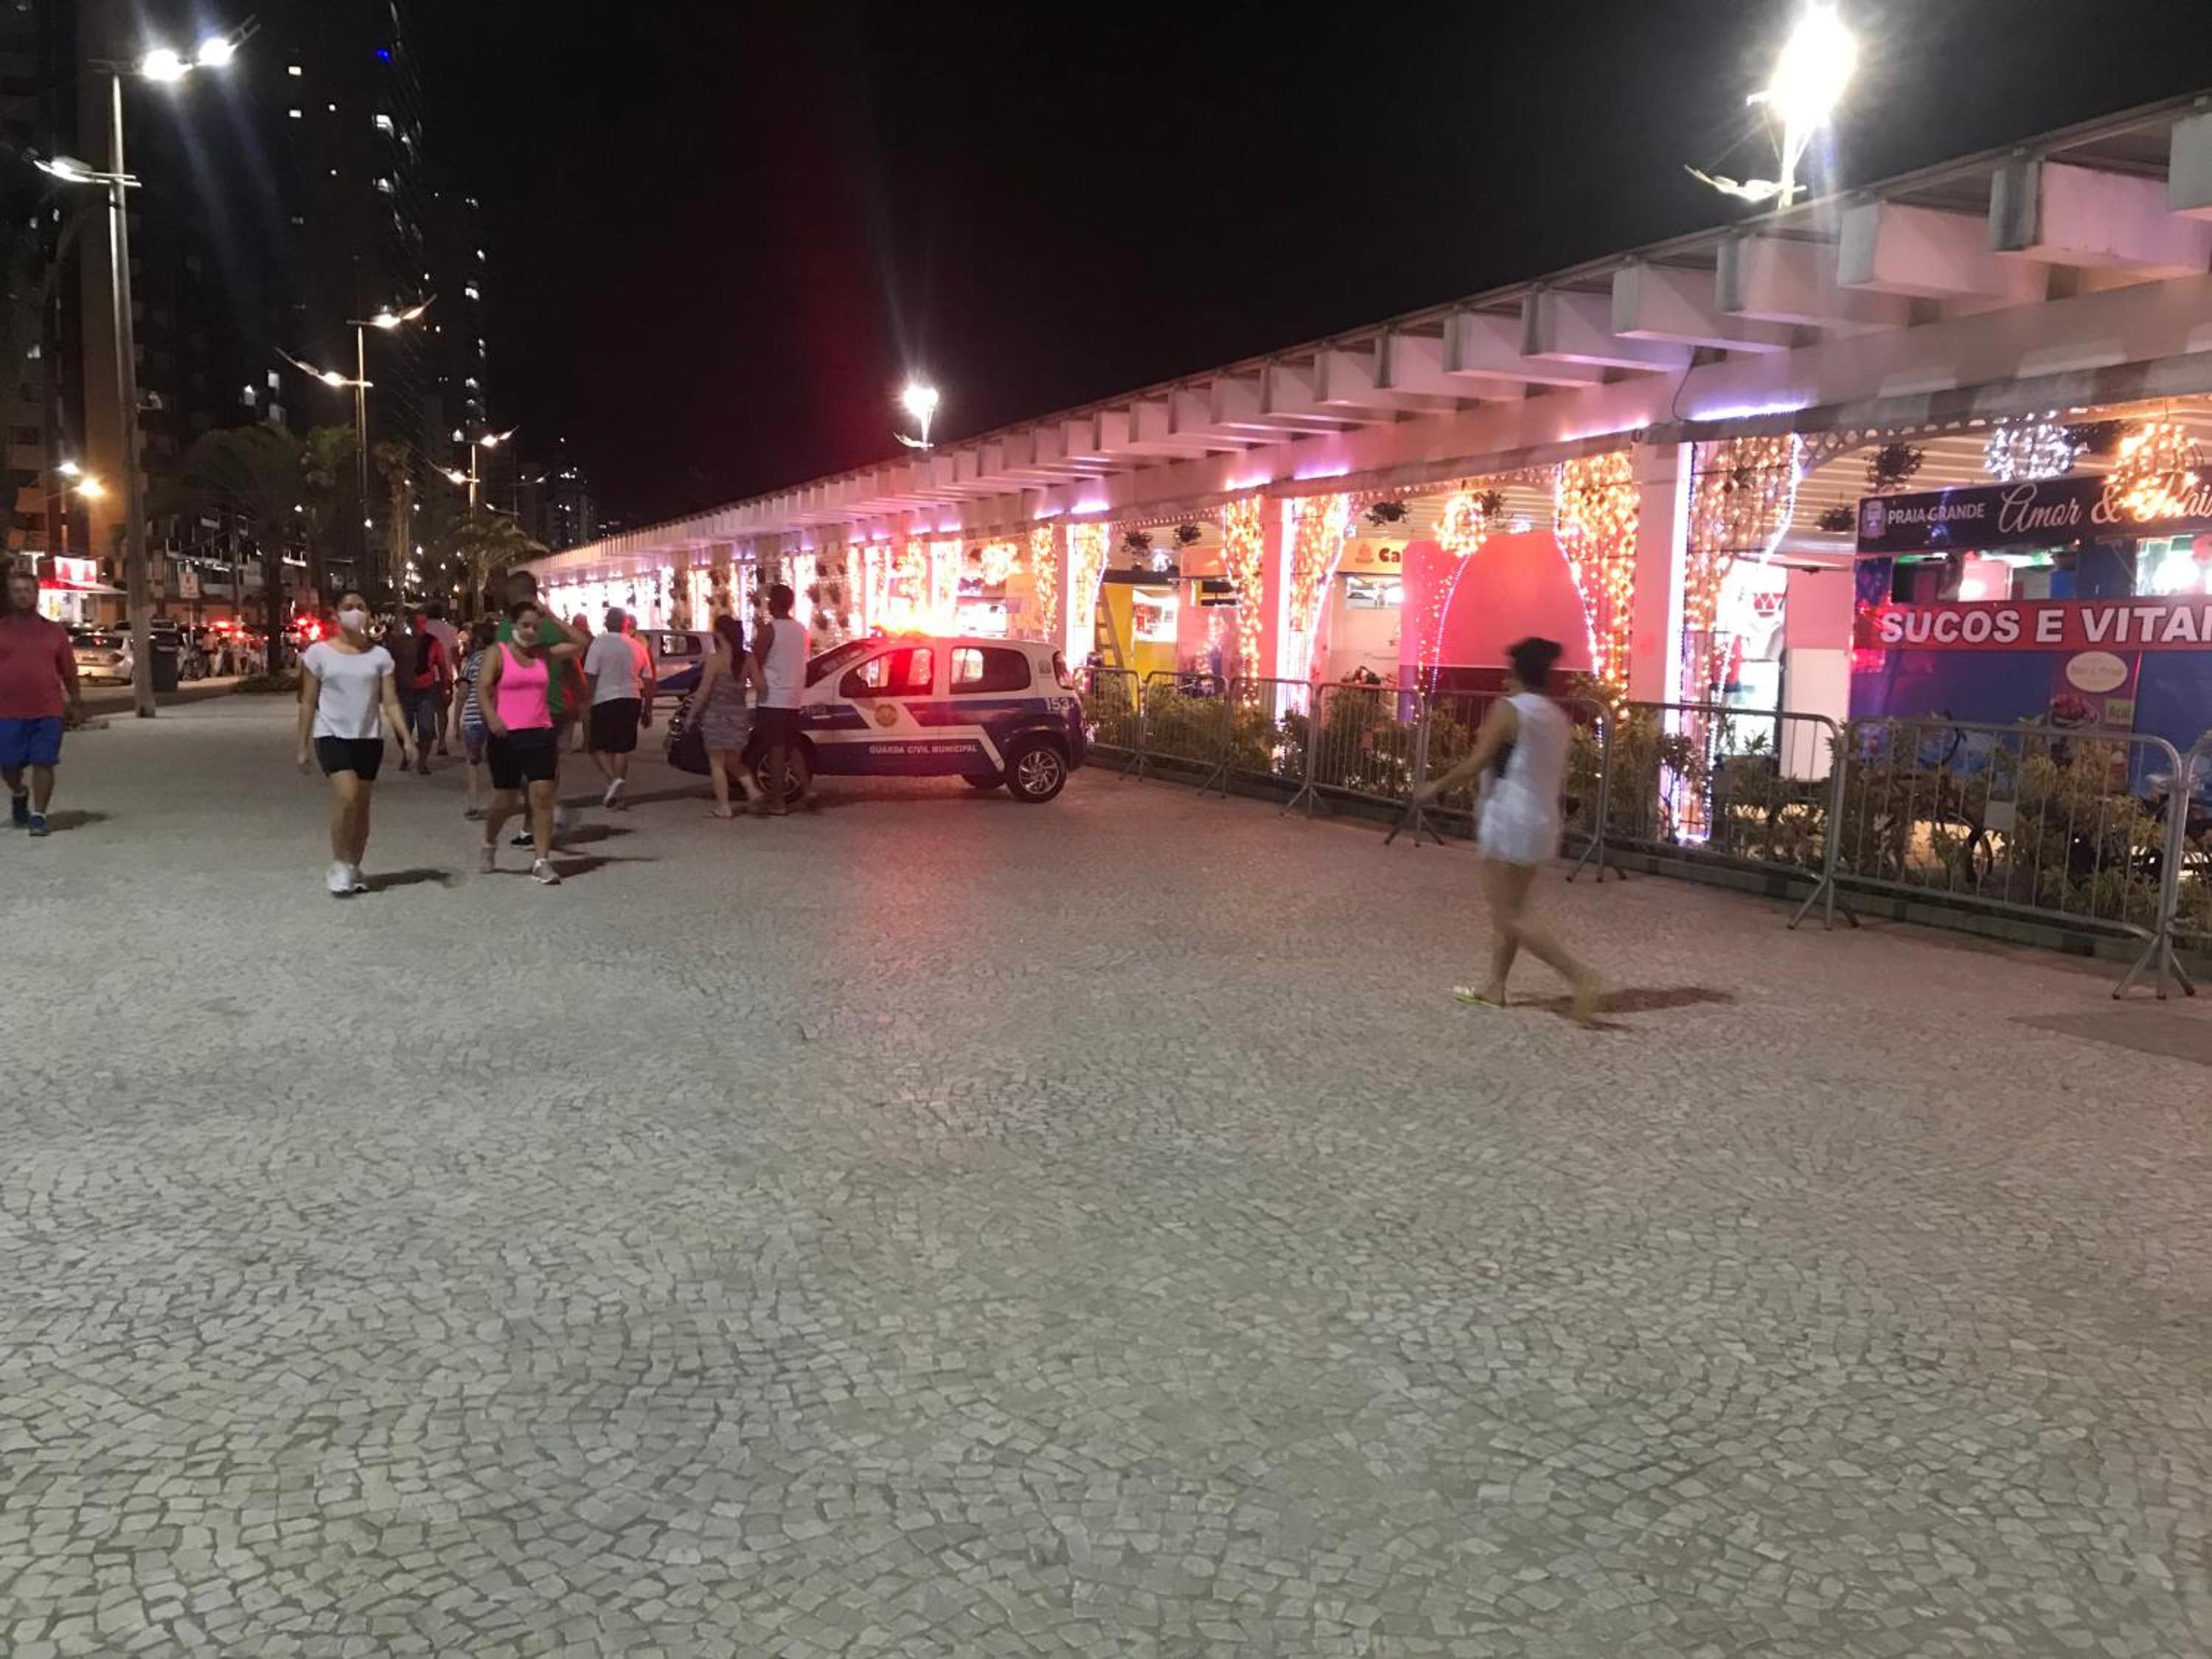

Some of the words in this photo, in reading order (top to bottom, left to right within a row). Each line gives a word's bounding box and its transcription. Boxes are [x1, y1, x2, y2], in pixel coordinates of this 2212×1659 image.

[1888, 507, 1925, 524] PRAIA
[1929, 504, 1985, 521] GRANDE
[1998, 483, 2082, 532] Amor
[2091, 483, 2122, 524] &
[1879, 608, 2020, 643] SUCOS
[2034, 609, 2064, 643] E
[1045, 698, 1070, 711] 153
[869, 745, 905, 754] GUARDA
[906, 745, 931, 754] CIVIL
[931, 744, 978, 754] MUNICIPAL
